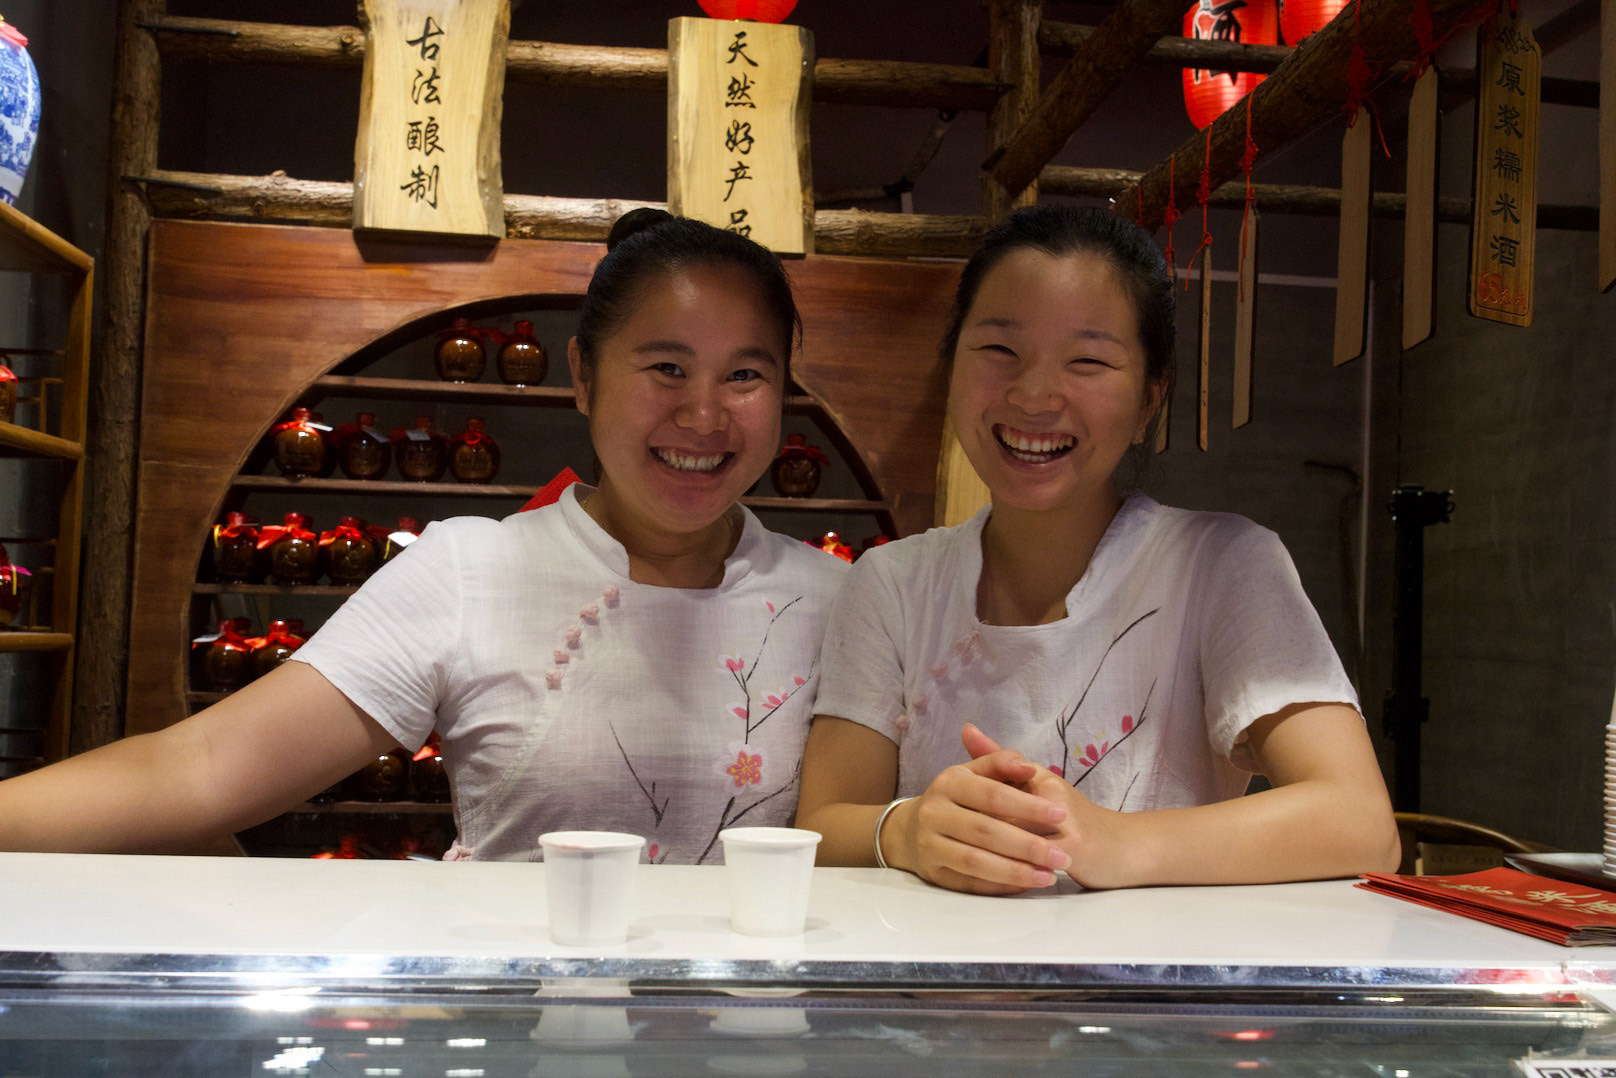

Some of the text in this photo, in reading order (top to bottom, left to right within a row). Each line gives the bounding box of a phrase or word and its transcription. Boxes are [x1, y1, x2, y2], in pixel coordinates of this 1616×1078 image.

[400, 16, 445, 209] 古法酿制
[723, 31, 759, 239] 天然好产品
[1490, 61, 1526, 268] 原浆糯米酒
